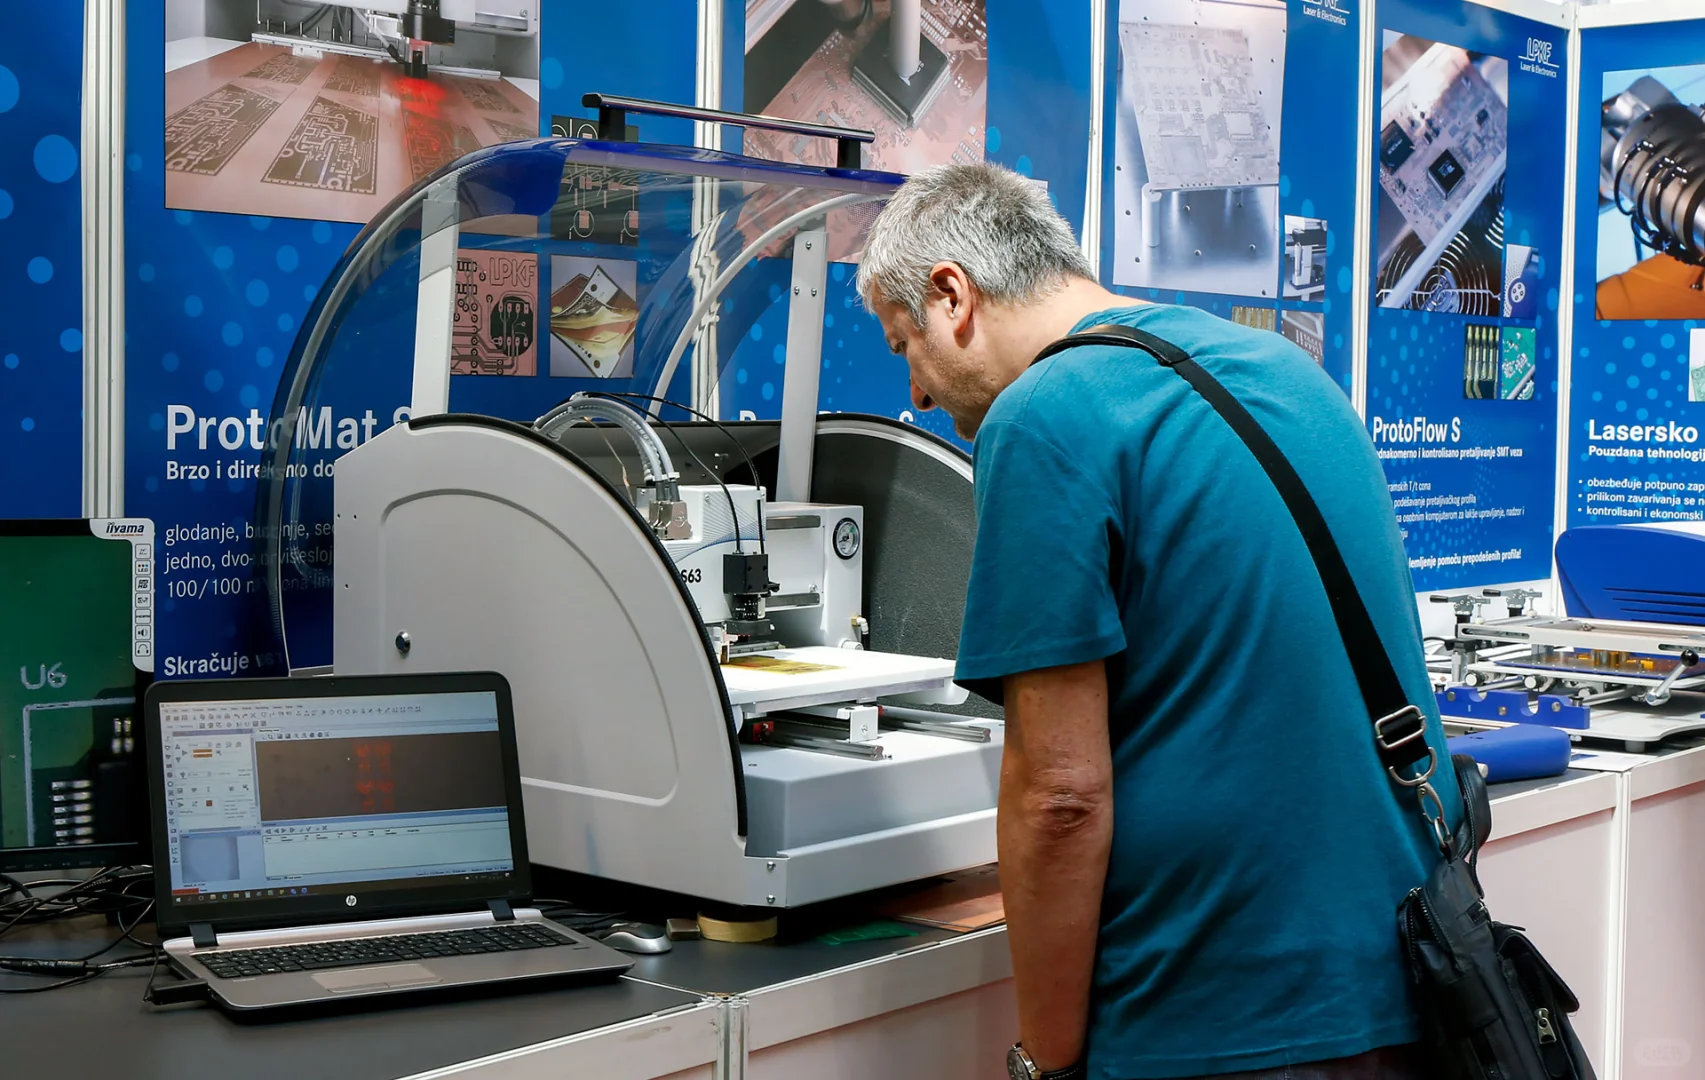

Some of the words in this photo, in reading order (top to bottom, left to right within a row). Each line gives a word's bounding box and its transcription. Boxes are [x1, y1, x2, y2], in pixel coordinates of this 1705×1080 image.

[1303, 4, 1316, 17] Laser
[1317, 8, 1321, 18] &
[1527, 37, 1552, 63] LPKF
[1520, 61, 1531, 72] Laser
[489, 257, 537, 288] LPKF
[1373, 416, 1448, 443] ProtoFlow
[1450, 416, 1461, 443] S
[1589, 419, 1699, 443] Lasersko
[1418, 447, 1421, 458] i
[1422, 447, 1459, 458] kontrolisano
[1460, 447, 1496, 460] pretaljivanje
[1497, 446, 1510, 457] SMT
[1510, 449, 1523, 457] veza
[1588, 445, 1644, 457] Pouzdana
[166, 460, 210, 480] Brzo
[216, 460, 221, 479] i
[1418, 482, 1431, 491] cona
[1587, 477, 1642, 490] obezbeđuje
[1644, 480, 1685, 491] potpuno
[1394, 496, 1426, 509] podešavanje
[1461, 493, 1476, 506] profila
[1587, 492, 1625, 502] prilikom
[1627, 494, 1681, 506] zavarivanja
[1683, 497, 1696, 505] se
[1403, 511, 1425, 522] osobnim
[1425, 511, 1458, 523] kompjuterom
[1587, 505, 1642, 517] kontrolisani
[1644, 508, 1648, 517] i
[1650, 510, 1704, 520] ekonomski
[106, 522, 145, 534] iiyama
[165, 523, 239, 546] glodanje,
[164, 551, 216, 575] jedno,
[1462, 549, 1501, 566] prepodešenih
[1501, 548, 1522, 562] profila!
[680, 568, 702, 584] S63
[168, 577, 241, 600] 100/100
[164, 652, 249, 676] Skračuje
[20, 662, 67, 690] U6
